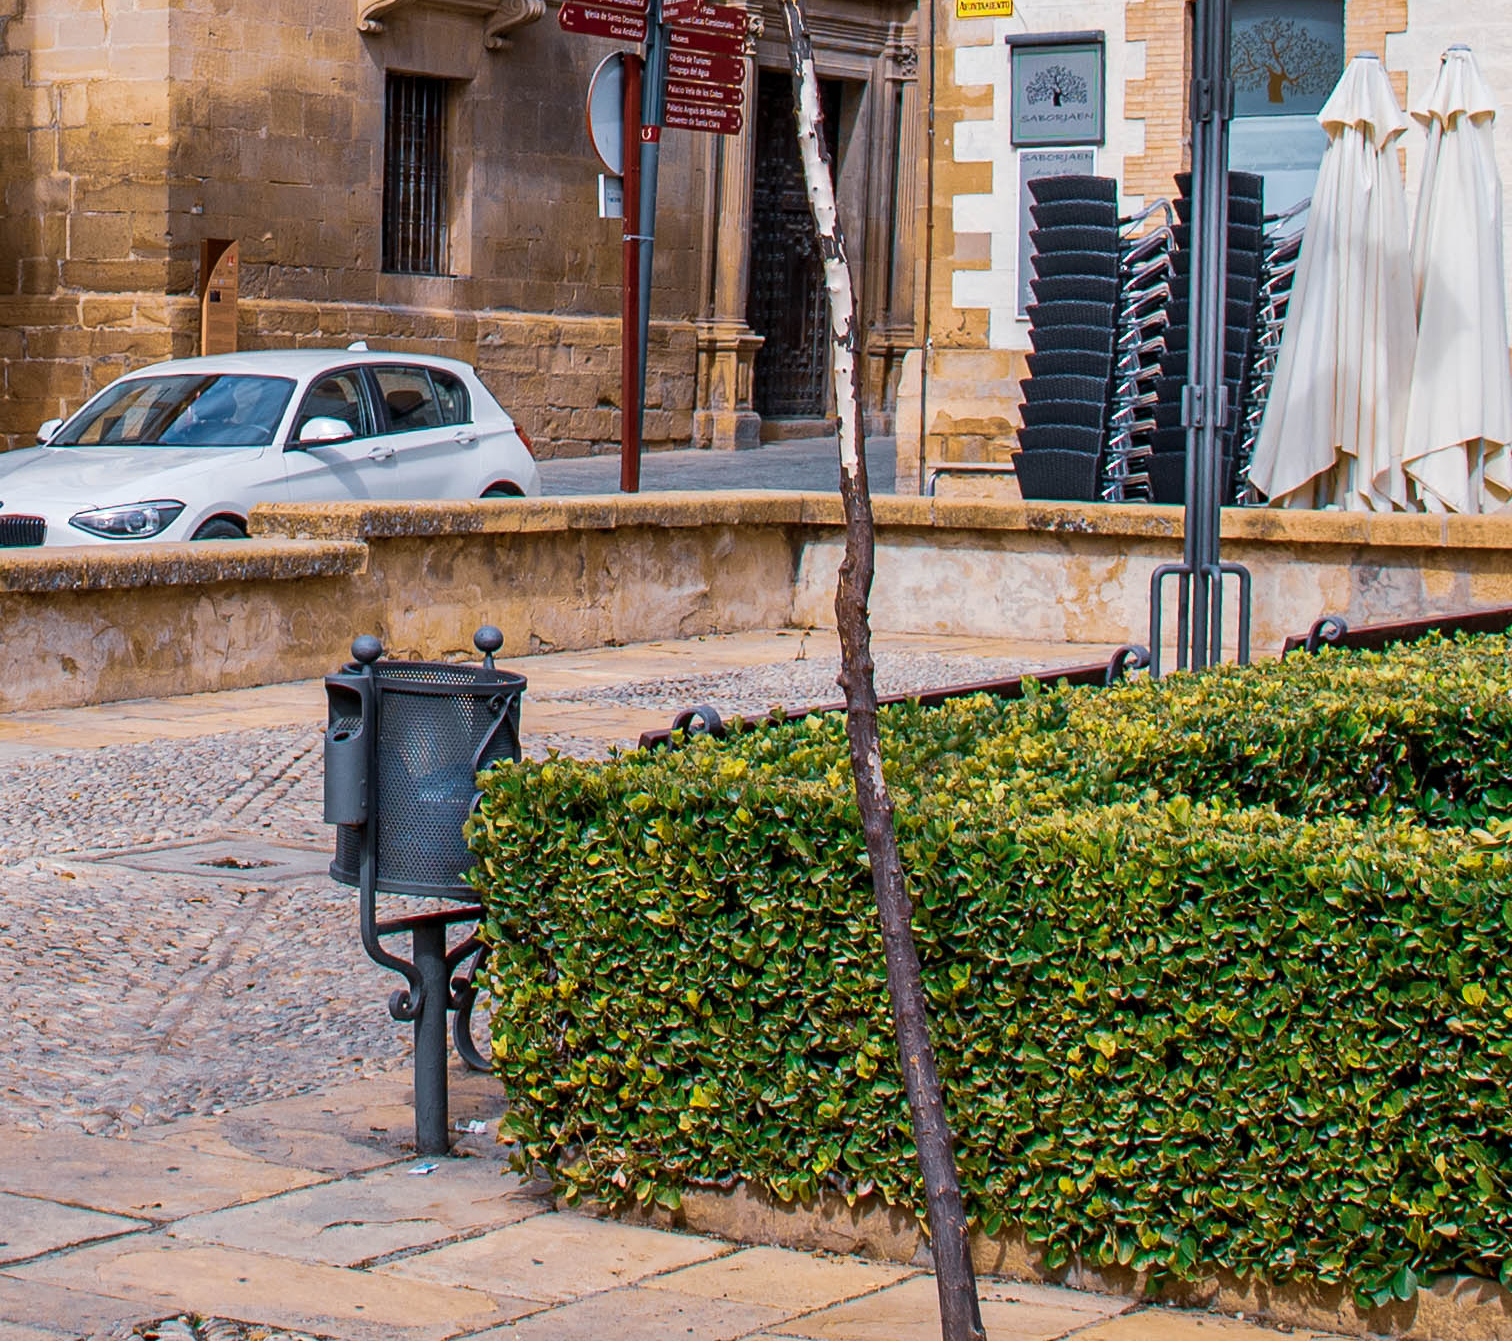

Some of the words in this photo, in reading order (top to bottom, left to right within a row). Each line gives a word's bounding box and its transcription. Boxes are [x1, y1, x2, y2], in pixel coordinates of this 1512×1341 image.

[960, 1, 1009, 10] AYUNTAMIENTO
[584, 9, 599, 20] Iglesia
[601, 12, 607, 20] de
[607, 13, 622, 23] Santo
[622, 15, 644, 27] Domingo
[610, 25, 622, 34] Casa
[670, 53, 686, 63] Oficina
[693, 56, 712, 66] Turismo
[698, 68, 710, 78] Agua
[668, 84, 684, 94] Palacio
